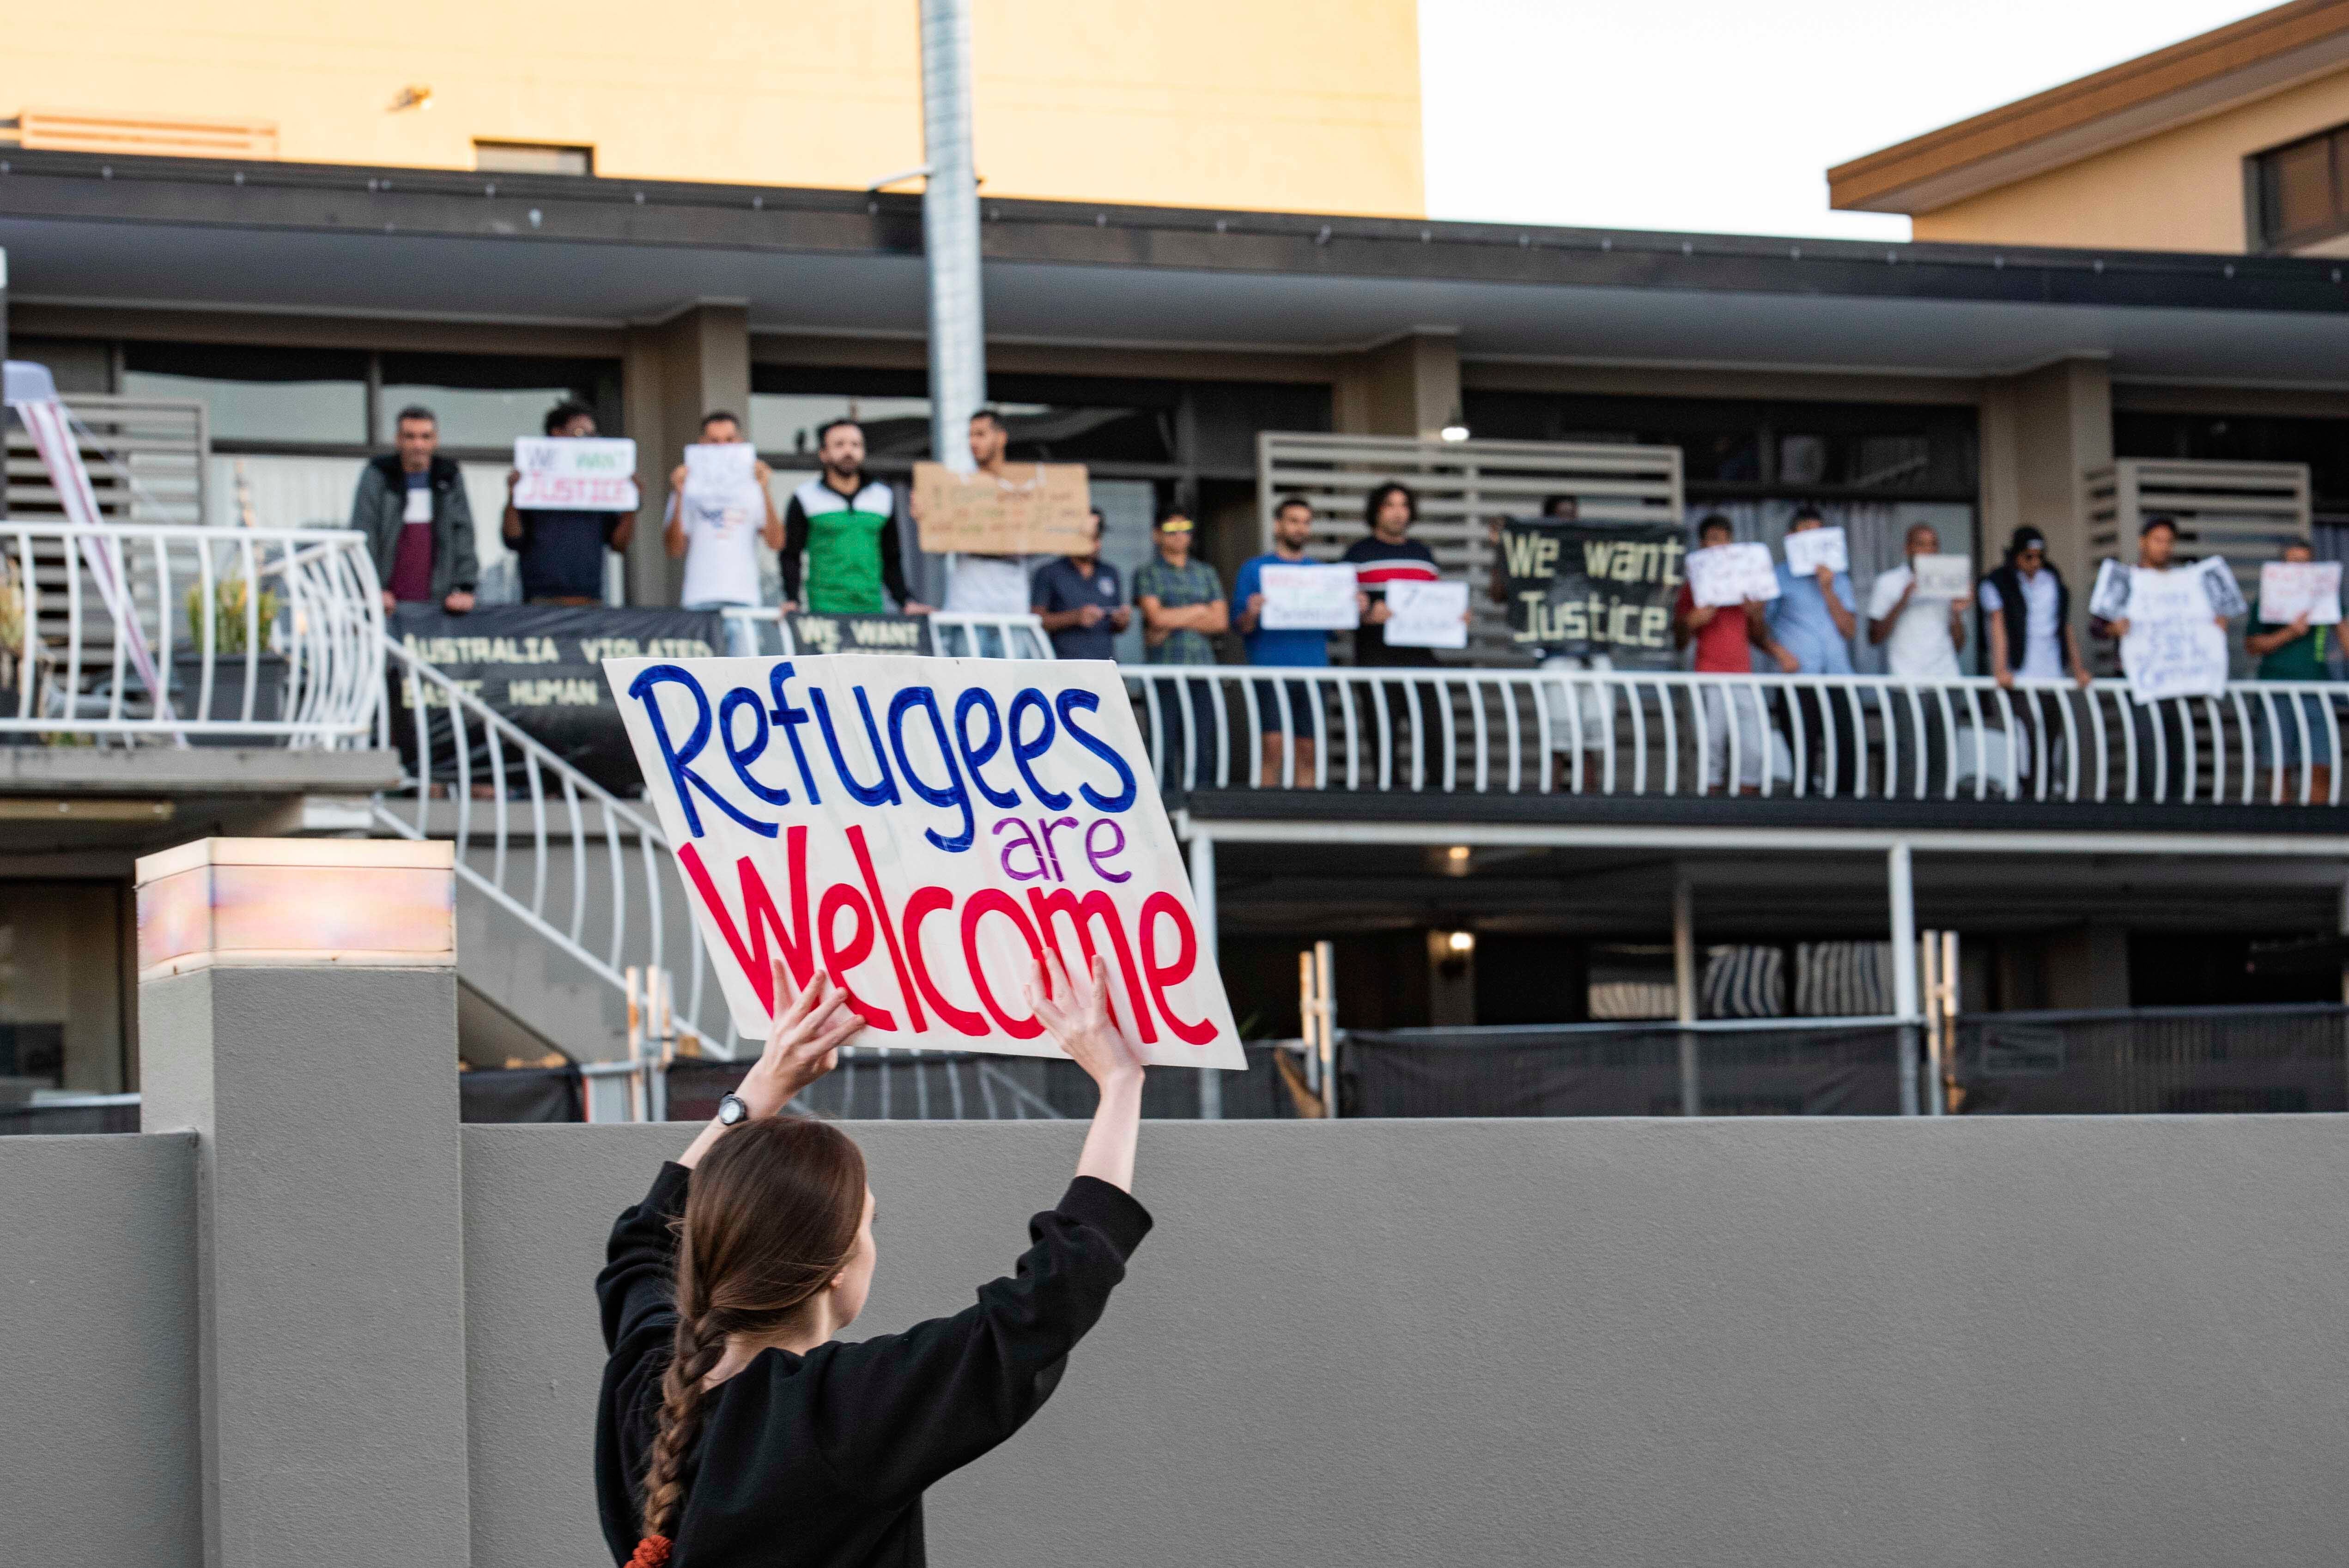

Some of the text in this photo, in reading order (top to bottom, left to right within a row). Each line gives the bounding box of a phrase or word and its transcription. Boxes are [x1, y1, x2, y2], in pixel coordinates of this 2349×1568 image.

[524, 468, 629, 502] JUSTICE
[1501, 530, 1560, 579] We
[1583, 536, 1685, 585] want
[850, 620, 920, 646] WANT
[1513, 589, 1669, 648] Justice
[403, 633, 560, 664] AUSTRALIA
[509, 679, 599, 706] HUMAN
[628, 662, 1137, 852] Refugees
[992, 816, 1133, 884] are
[678, 825, 1220, 1046] Welcome
